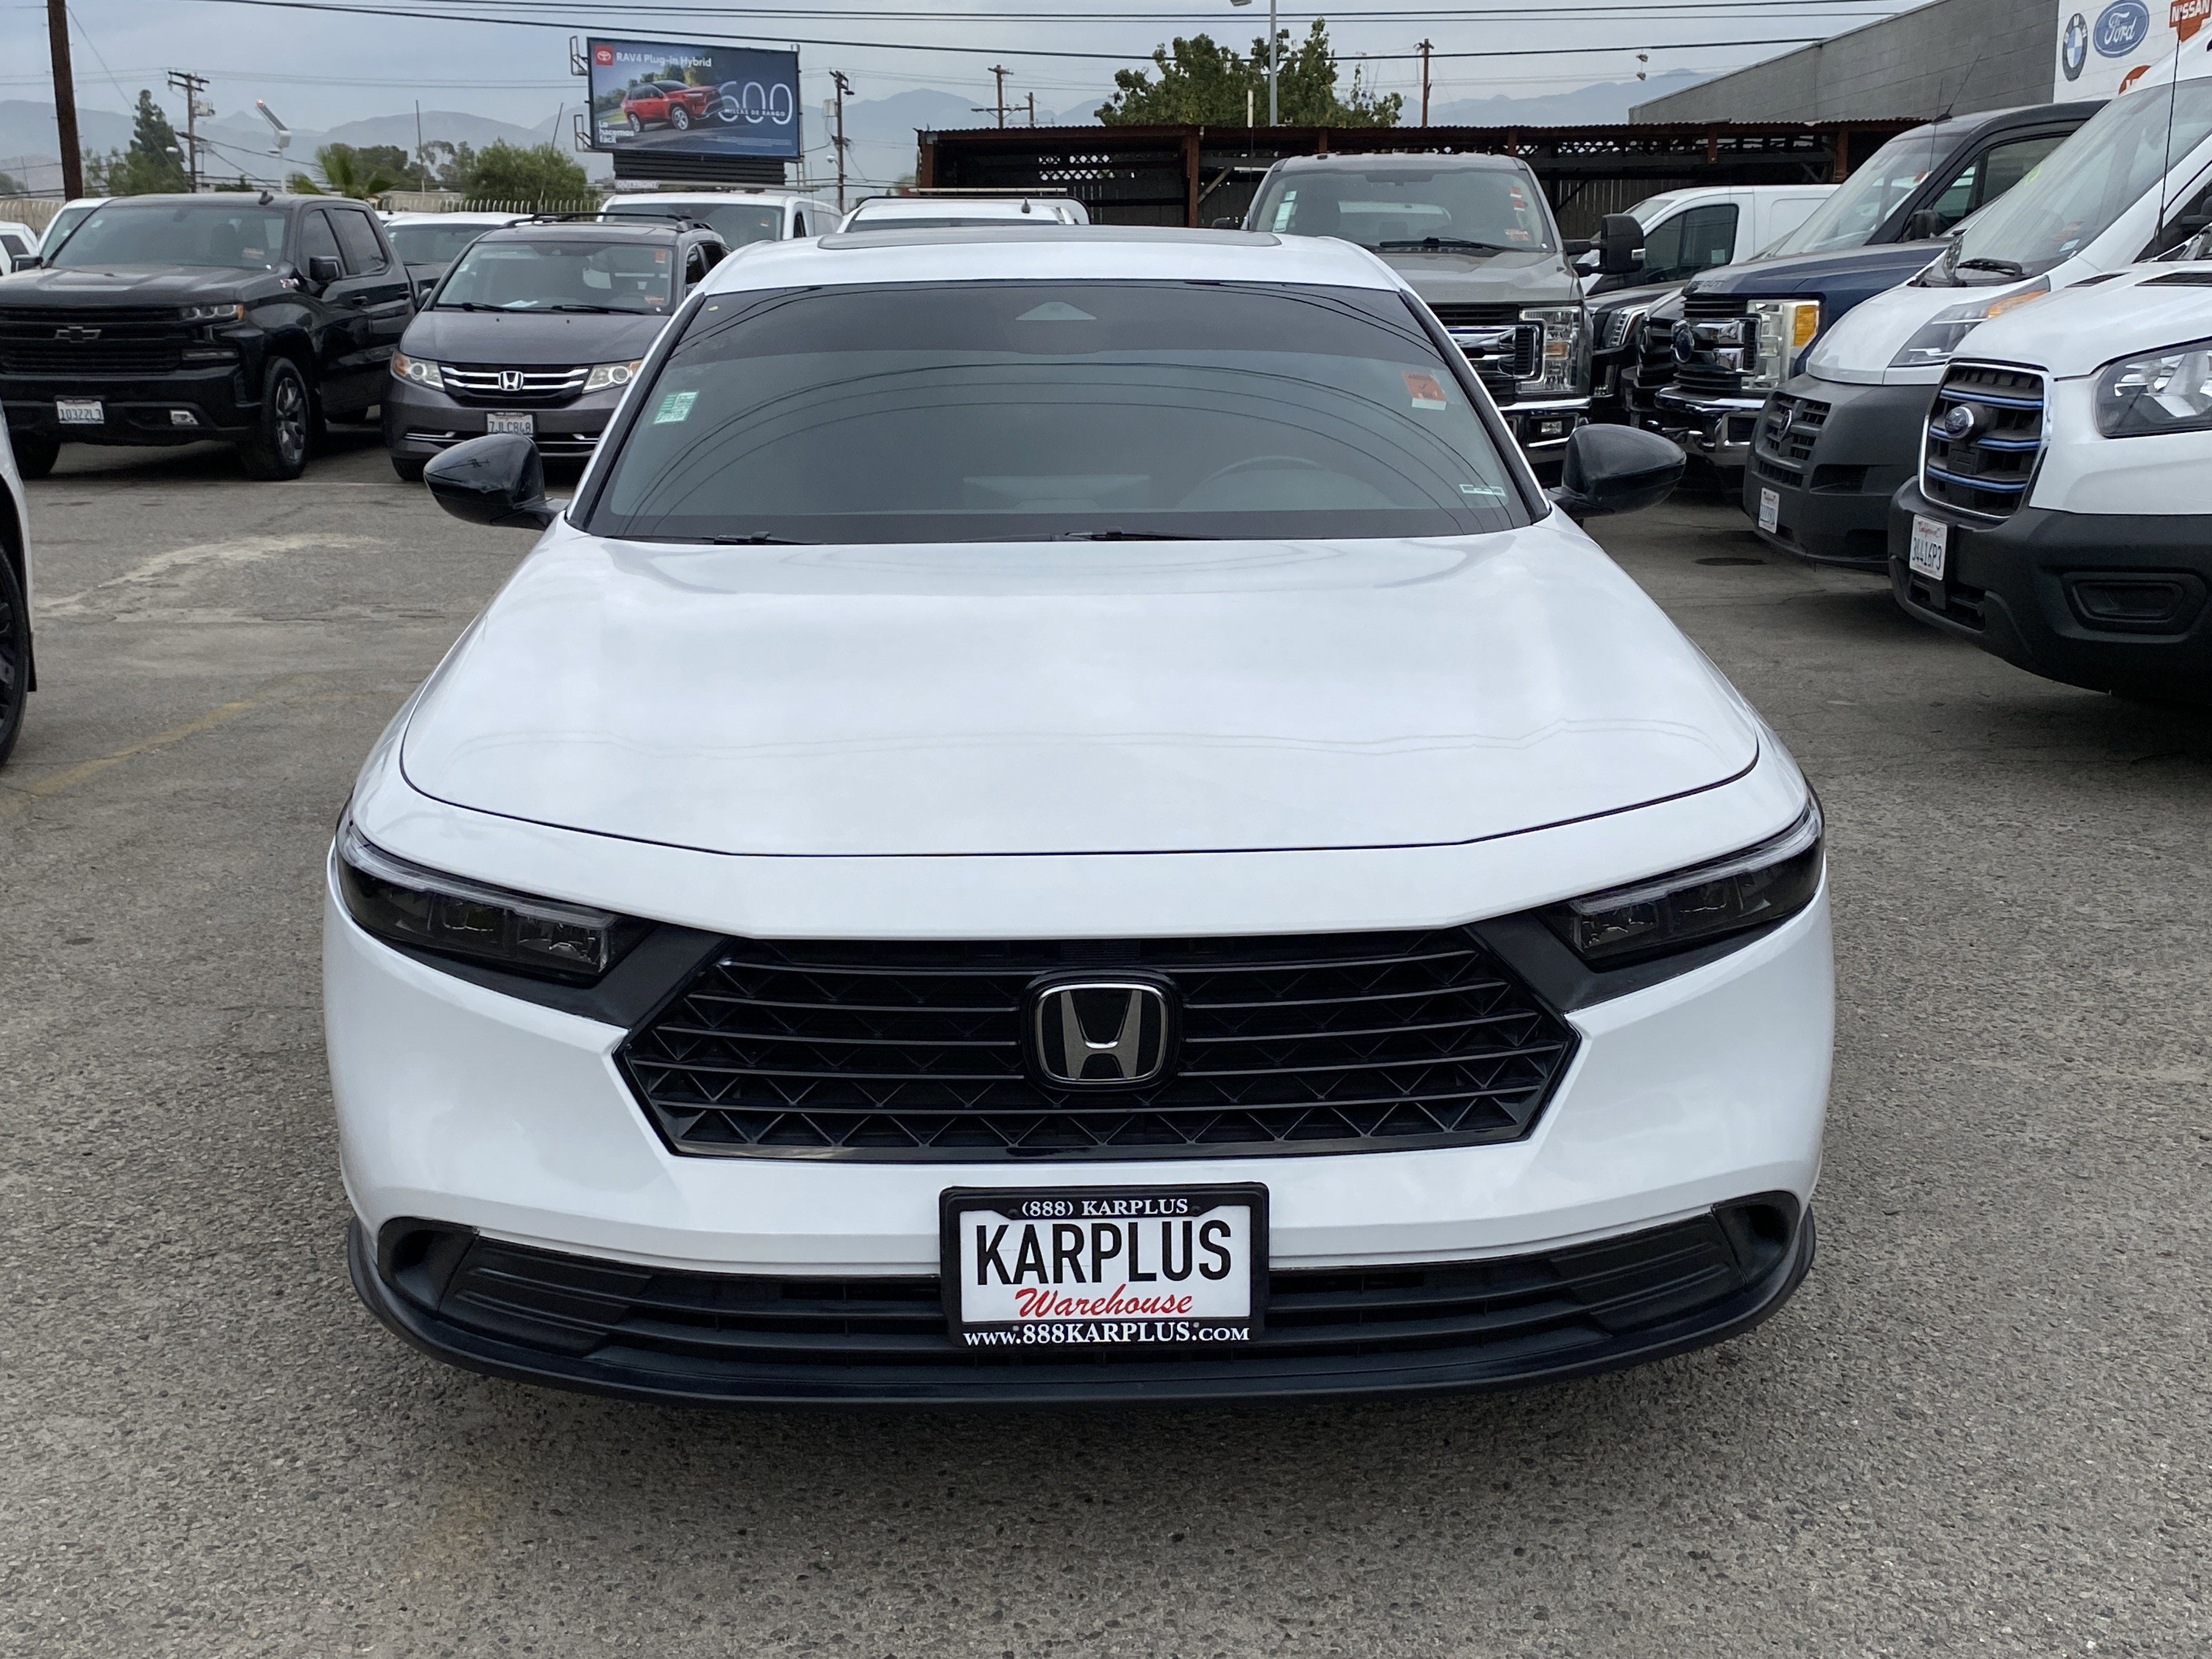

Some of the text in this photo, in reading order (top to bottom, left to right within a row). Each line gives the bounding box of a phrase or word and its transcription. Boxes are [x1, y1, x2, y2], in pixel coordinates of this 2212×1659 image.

[2172, 0, 2210, 22] NISSAN
[2104, 12, 2137, 45] Ford
[616, 52, 712, 67] RAV4 Plug-in Hybrid
[718, 81, 793, 125] 600
[1022, 1198, 1189, 1217] (888) KARPLUS
[976, 1220, 1232, 1285] KARPLUS
[1014, 1284, 1193, 1318] Warehouse
